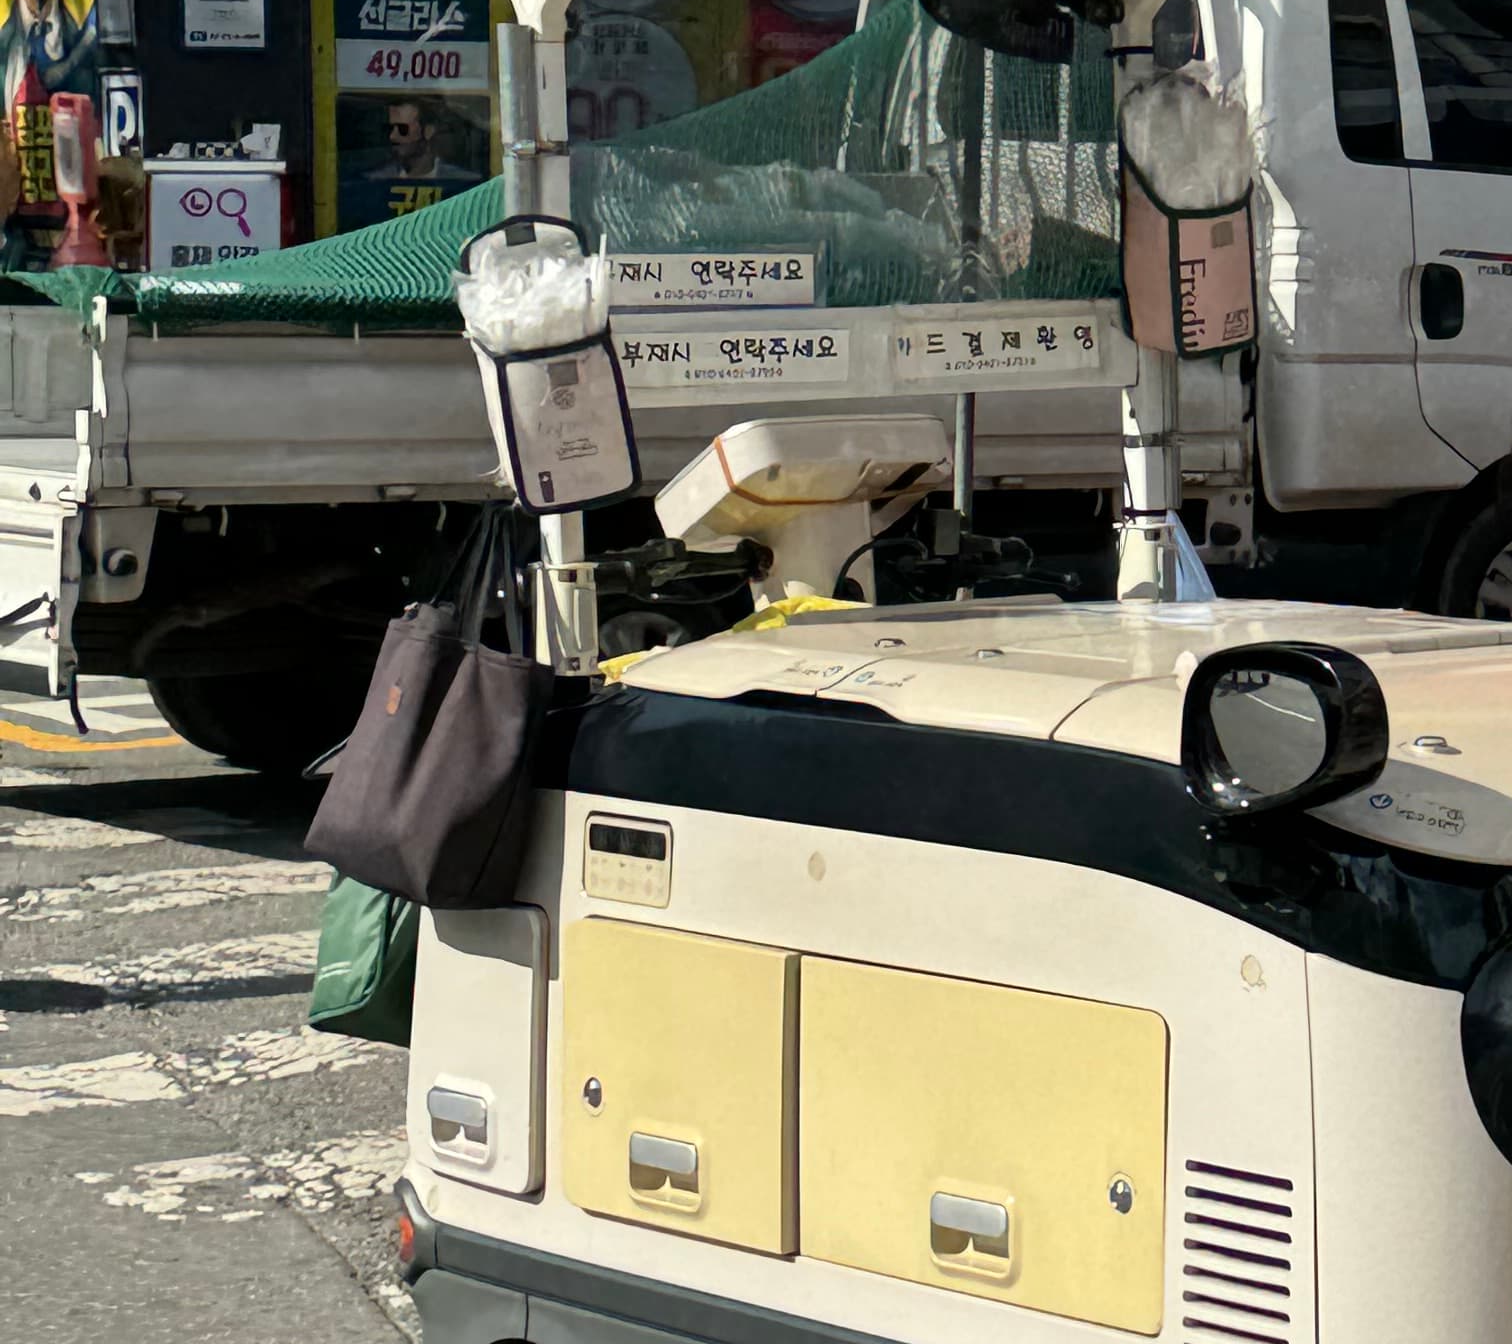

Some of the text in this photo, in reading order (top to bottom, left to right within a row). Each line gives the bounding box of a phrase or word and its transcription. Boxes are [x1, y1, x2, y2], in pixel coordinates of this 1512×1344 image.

[357, 0, 465, 32] 선글라스
[366, 49, 461, 83] 49,000
[691, 258, 804, 287] 연락주세요
[622, 335, 838, 368] 부재시 연락주세요
